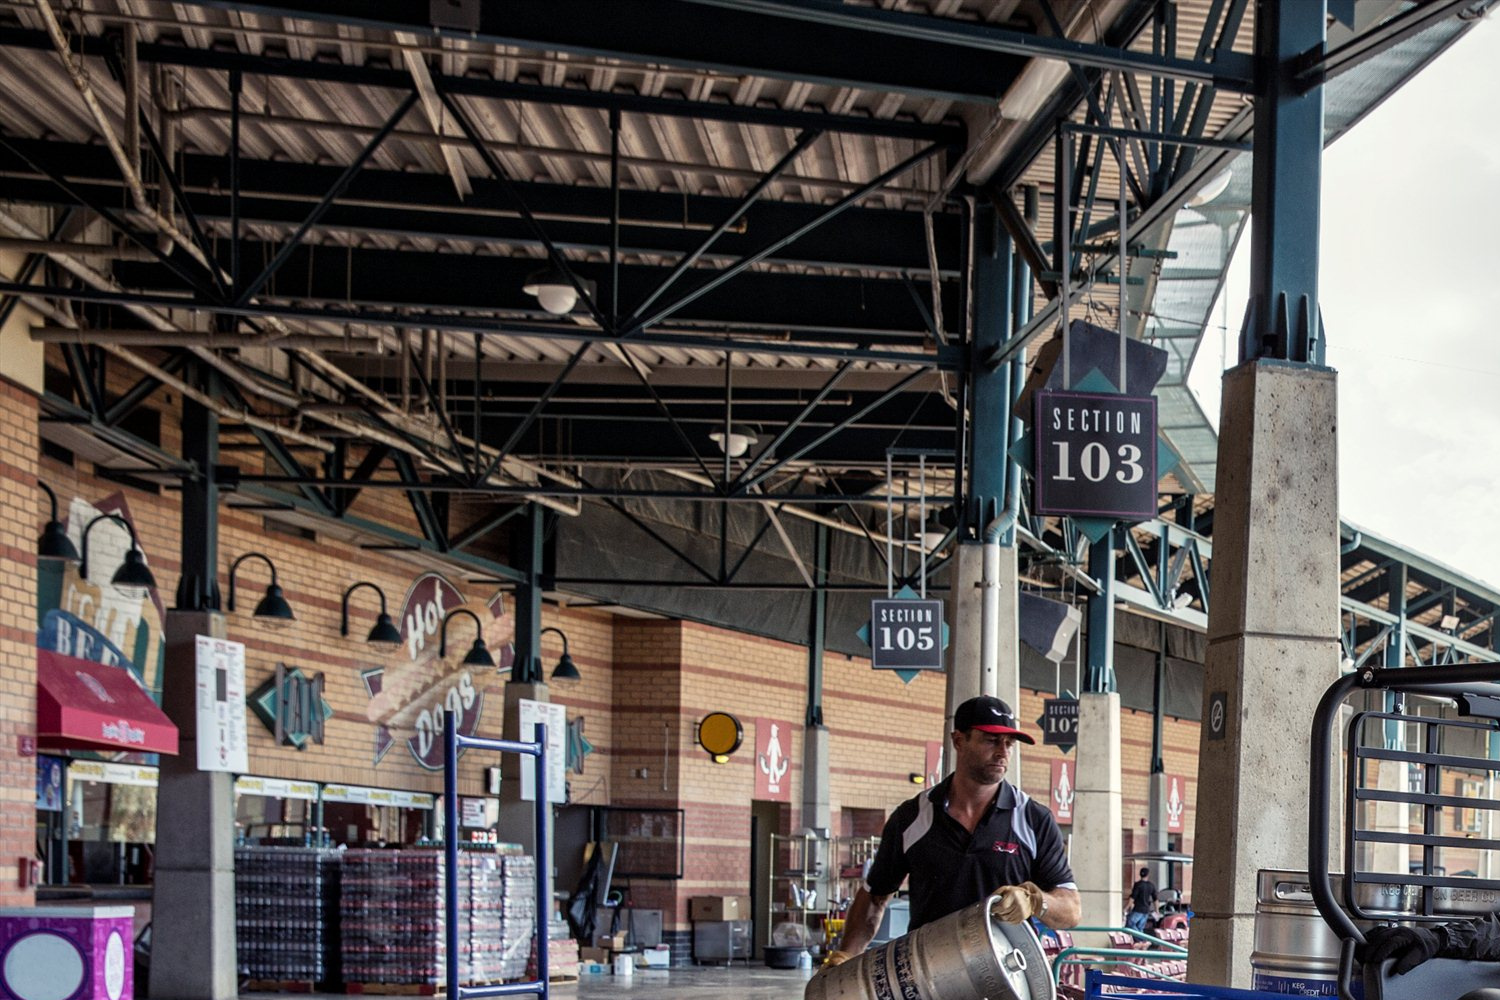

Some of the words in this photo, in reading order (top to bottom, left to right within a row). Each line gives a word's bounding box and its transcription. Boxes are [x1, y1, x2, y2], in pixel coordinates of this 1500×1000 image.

[1053, 408, 1140, 434] SECTION
[1052, 442, 1144, 484] 103
[881, 609, 932, 622] SECTION
[880, 626, 934, 650] 105
[1049, 717, 1078, 733] 107
